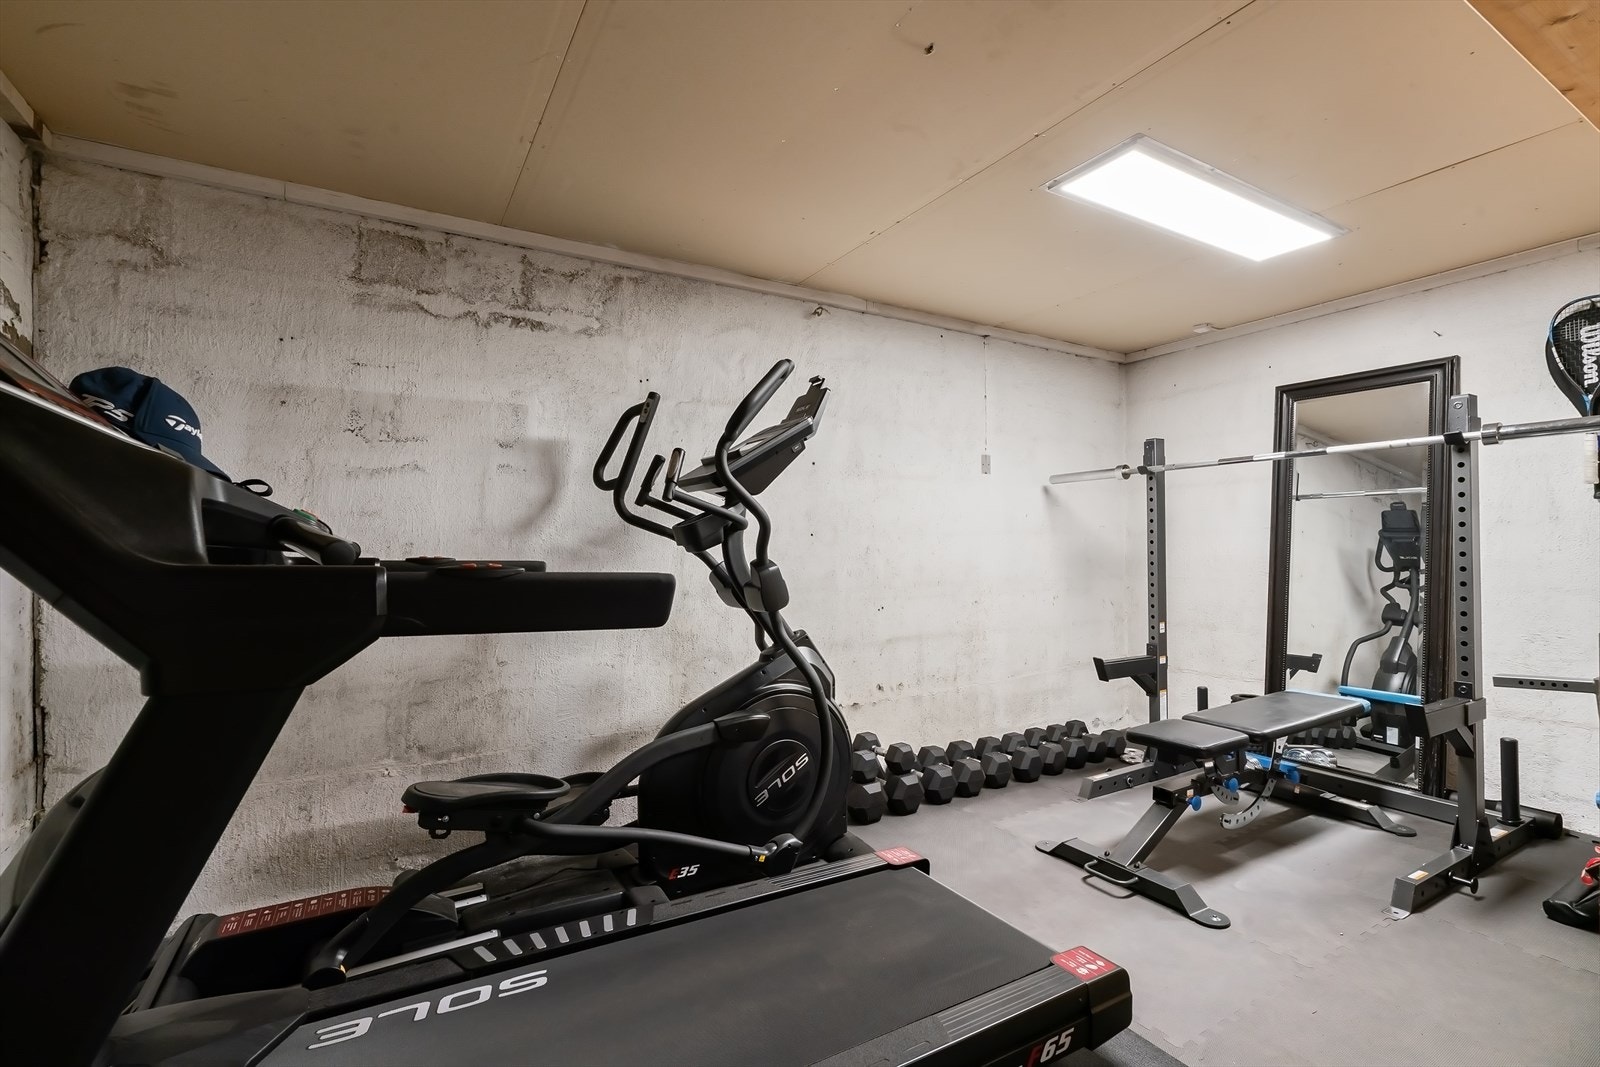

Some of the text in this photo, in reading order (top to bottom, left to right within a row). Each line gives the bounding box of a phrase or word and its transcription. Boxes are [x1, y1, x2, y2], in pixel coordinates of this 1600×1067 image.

[165, 414, 202, 440] Tayl
[754, 752, 809, 807] SOLE
[307, 969, 548, 1050] SOLE
